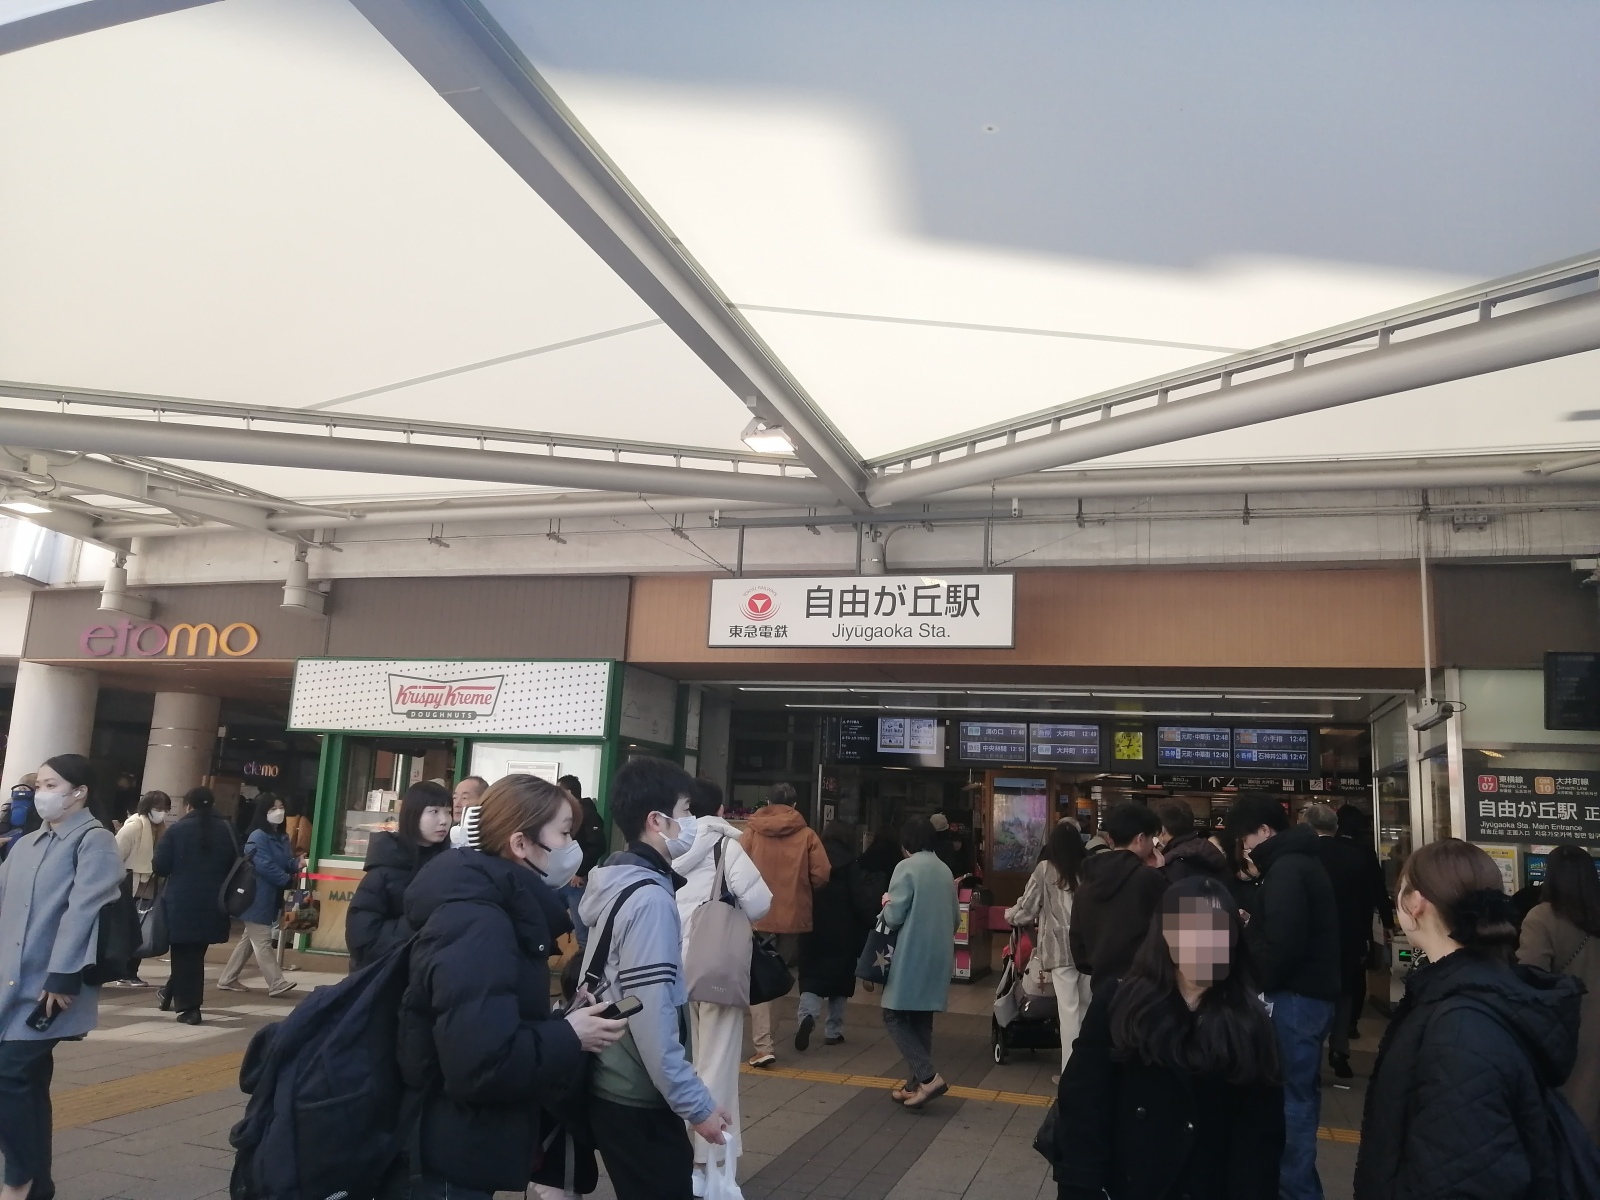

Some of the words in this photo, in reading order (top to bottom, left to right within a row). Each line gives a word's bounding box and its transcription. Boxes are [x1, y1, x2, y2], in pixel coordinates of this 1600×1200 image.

[806, 584, 980, 618] 自由が丘駅
[729, 625, 788, 638] 東急電鉄
[832, 623, 913, 641] Jiyūgaoka
[919, 623, 950, 638] Sta.
[80, 618, 258, 657] etomo
[394, 685, 447, 709] Krispy
[443, 685, 496, 706] Kreme
[411, 711, 472, 719] DOUGHNUTS
[1499, 775, 1524, 784] 東横線
[1556, 777, 1589, 786] 大井町線
[1482, 783, 1494, 791] 07
[1540, 785, 1551, 793] 10
[1479, 799, 1577, 820] 自由が丘駅
[1217, 816, 1223, 826] 2
[1551, 823, 1583, 831] Entrance
